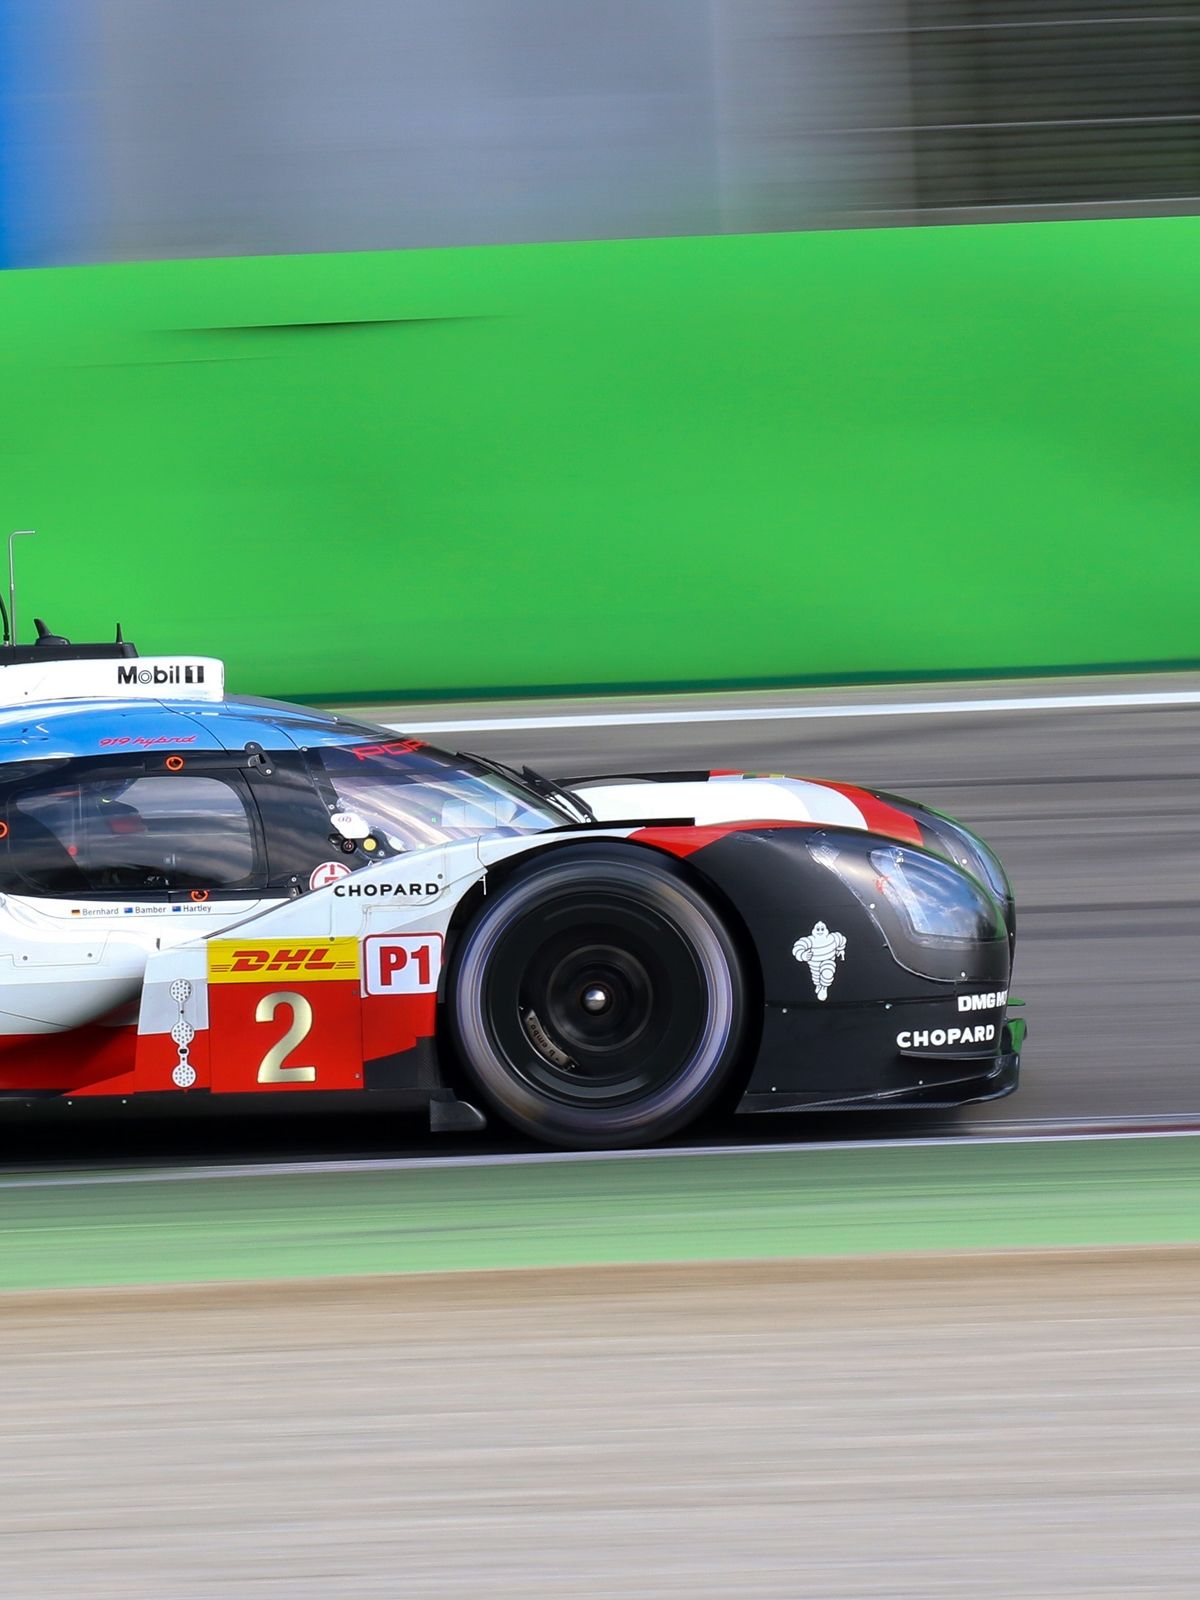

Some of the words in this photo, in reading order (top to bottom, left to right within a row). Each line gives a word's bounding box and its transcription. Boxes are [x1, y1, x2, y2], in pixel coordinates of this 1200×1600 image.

[117, 665, 180, 684] Mobil
[333, 883, 440, 898] CHOPARD
[82, 907, 119, 916] Bernhard
[135, 906, 167, 914] Bamber
[183, 904, 212, 914] Hartley
[230, 948, 337, 972] DHL
[379, 945, 431, 986] P1
[957, 992, 996, 1012] DMG
[255, 991, 316, 1084] 2
[896, 1024, 995, 1048] CHOPARD
